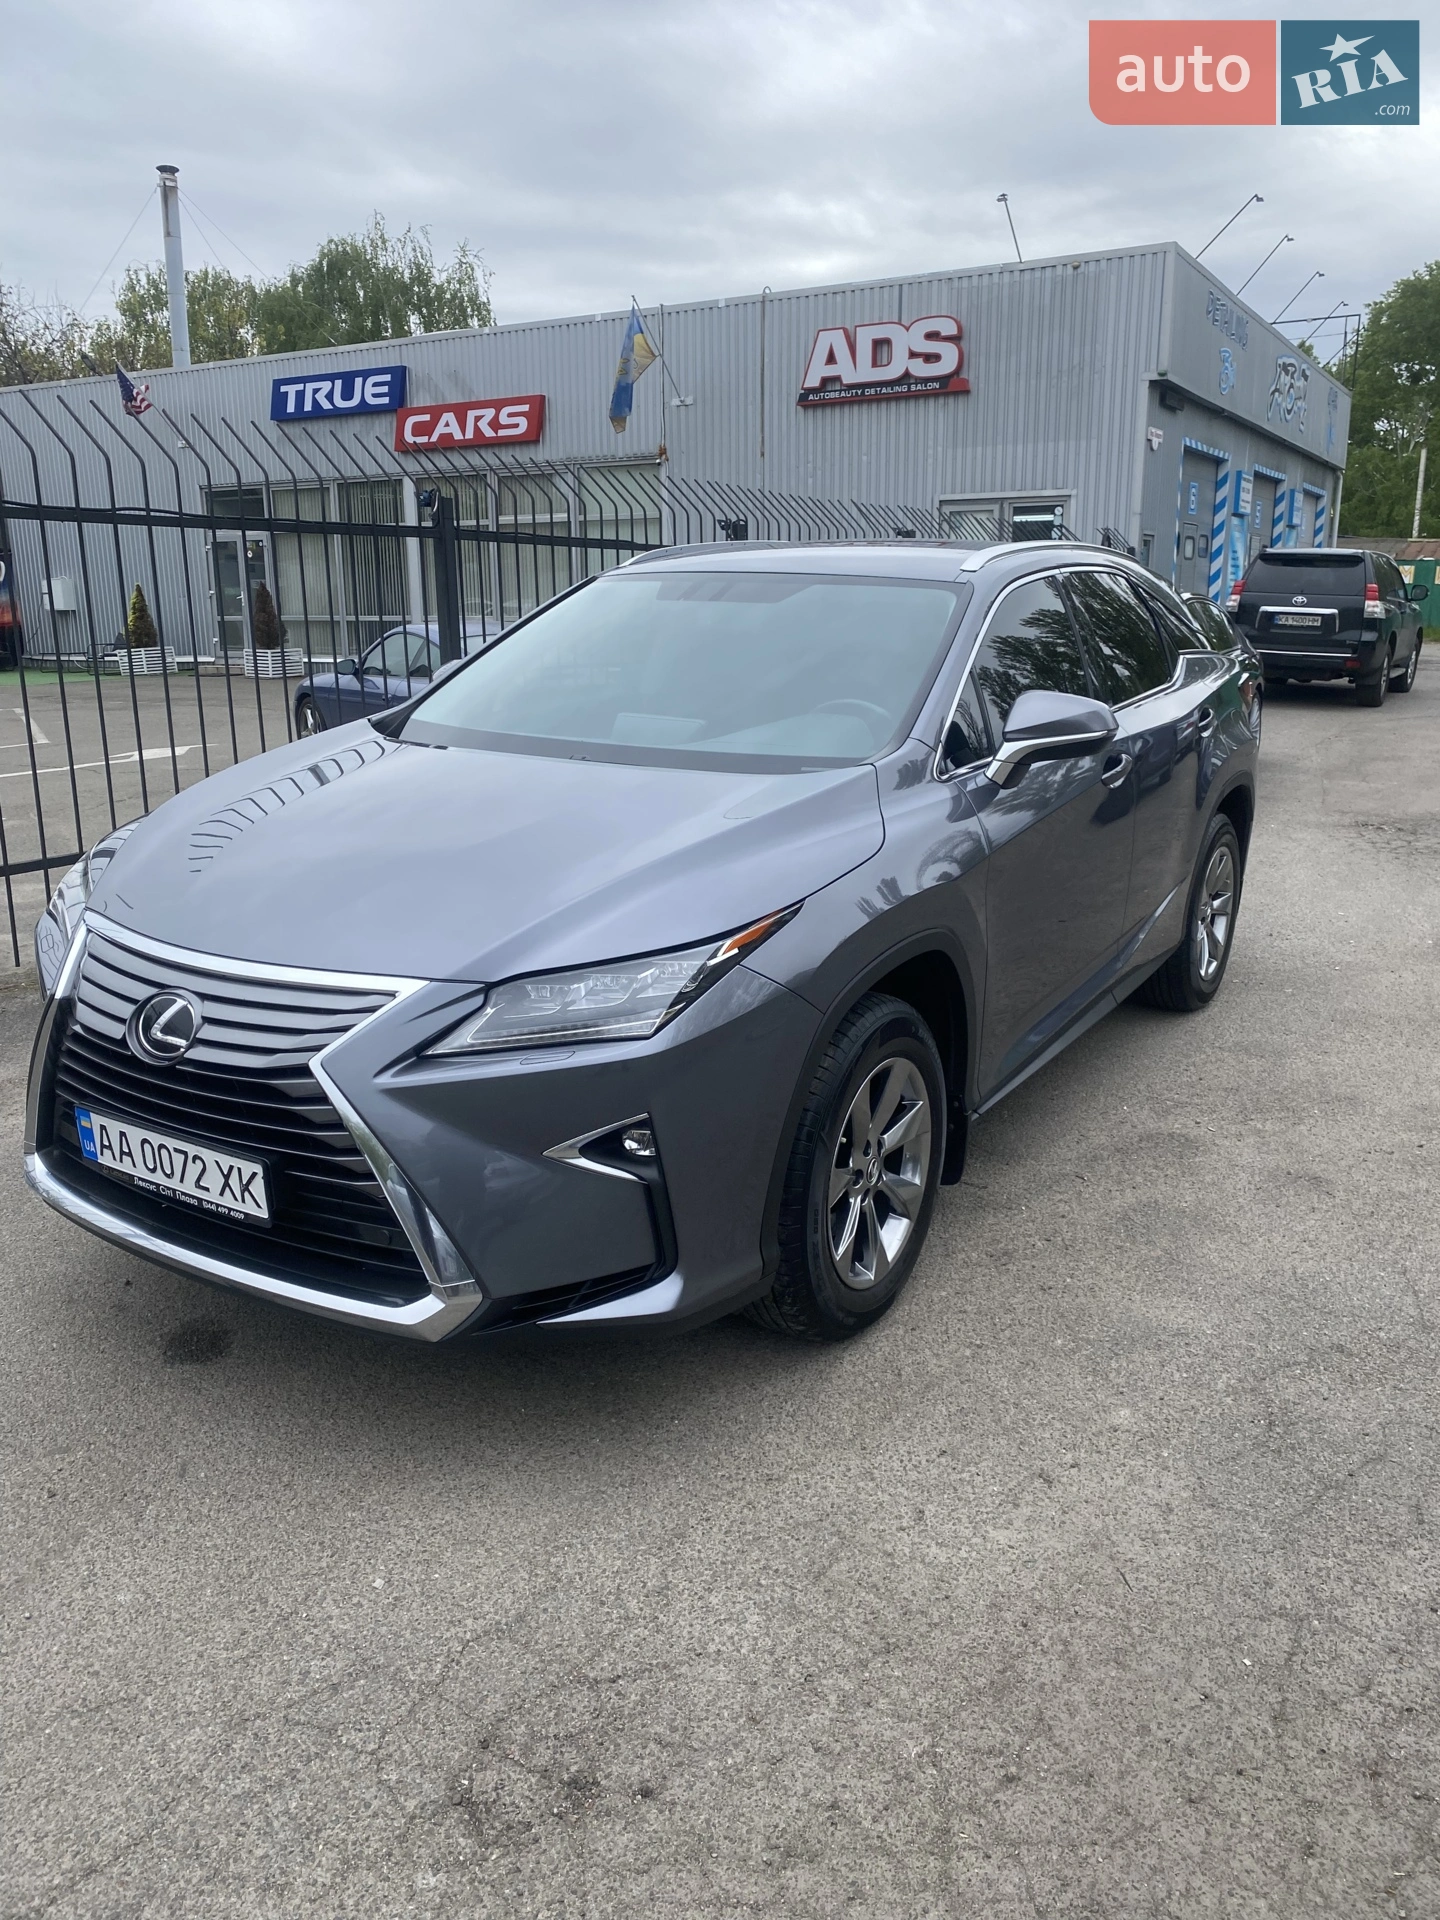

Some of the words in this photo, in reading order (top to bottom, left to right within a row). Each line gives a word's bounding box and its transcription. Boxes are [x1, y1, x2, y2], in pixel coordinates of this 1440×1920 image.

[801, 316, 962, 389] ADS
[280, 373, 391, 413] TRUE
[808, 389, 862, 400] AUTOBEAUTY
[865, 385, 908, 395] DETAILING
[910, 382, 940, 391] SALON
[404, 404, 530, 444] CARS
[85, 1139, 96, 1153] UA
[98, 1123, 137, 1169] AA
[140, 1138, 211, 1193] 0072
[214, 1158, 264, 1209] XK
[133, 1177, 157, 1191] Лексус
[175, 1191, 198, 1206] Плаза
[202, 1200, 217, 1212] (044)
[218, 1205, 229, 1215] 499
